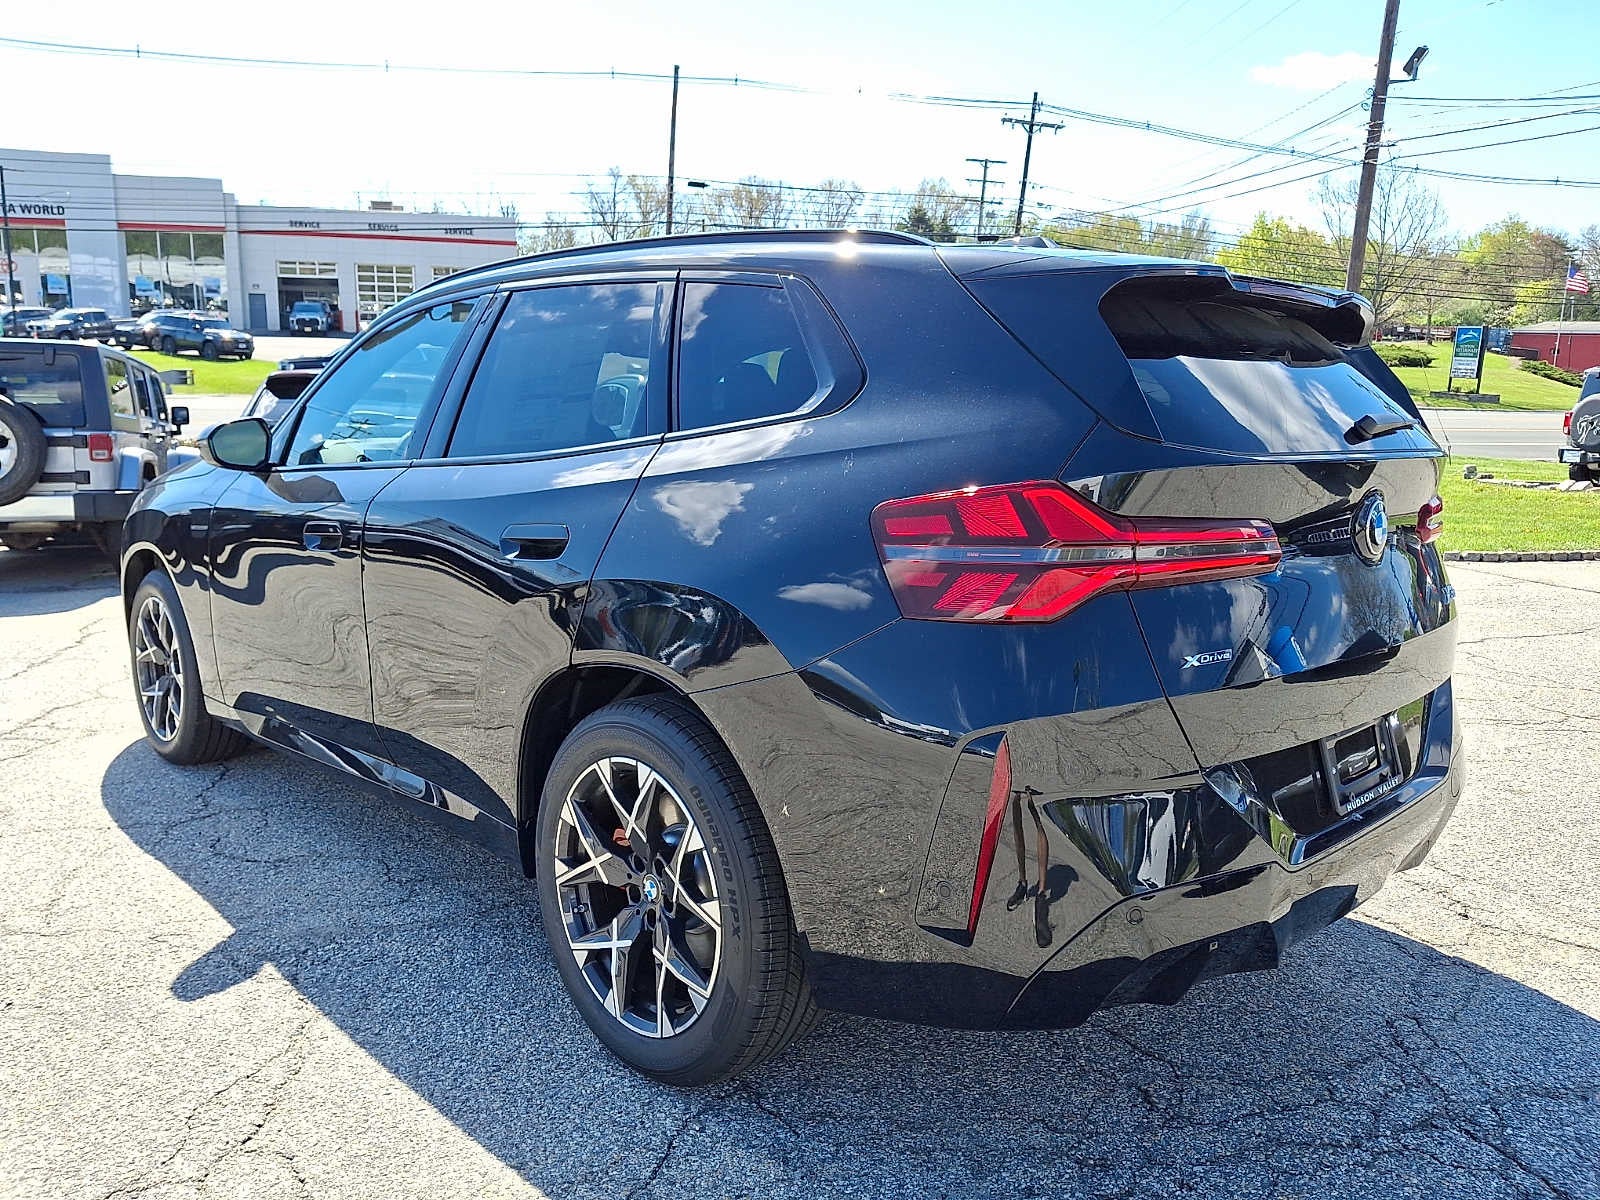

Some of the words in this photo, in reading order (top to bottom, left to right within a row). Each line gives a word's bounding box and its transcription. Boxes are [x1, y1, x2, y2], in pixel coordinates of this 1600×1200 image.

[19, 203, 65, 215] WORLD
[1346, 791, 1375, 812] HUDSON
[1377, 776, 1399, 794] VALLEY
